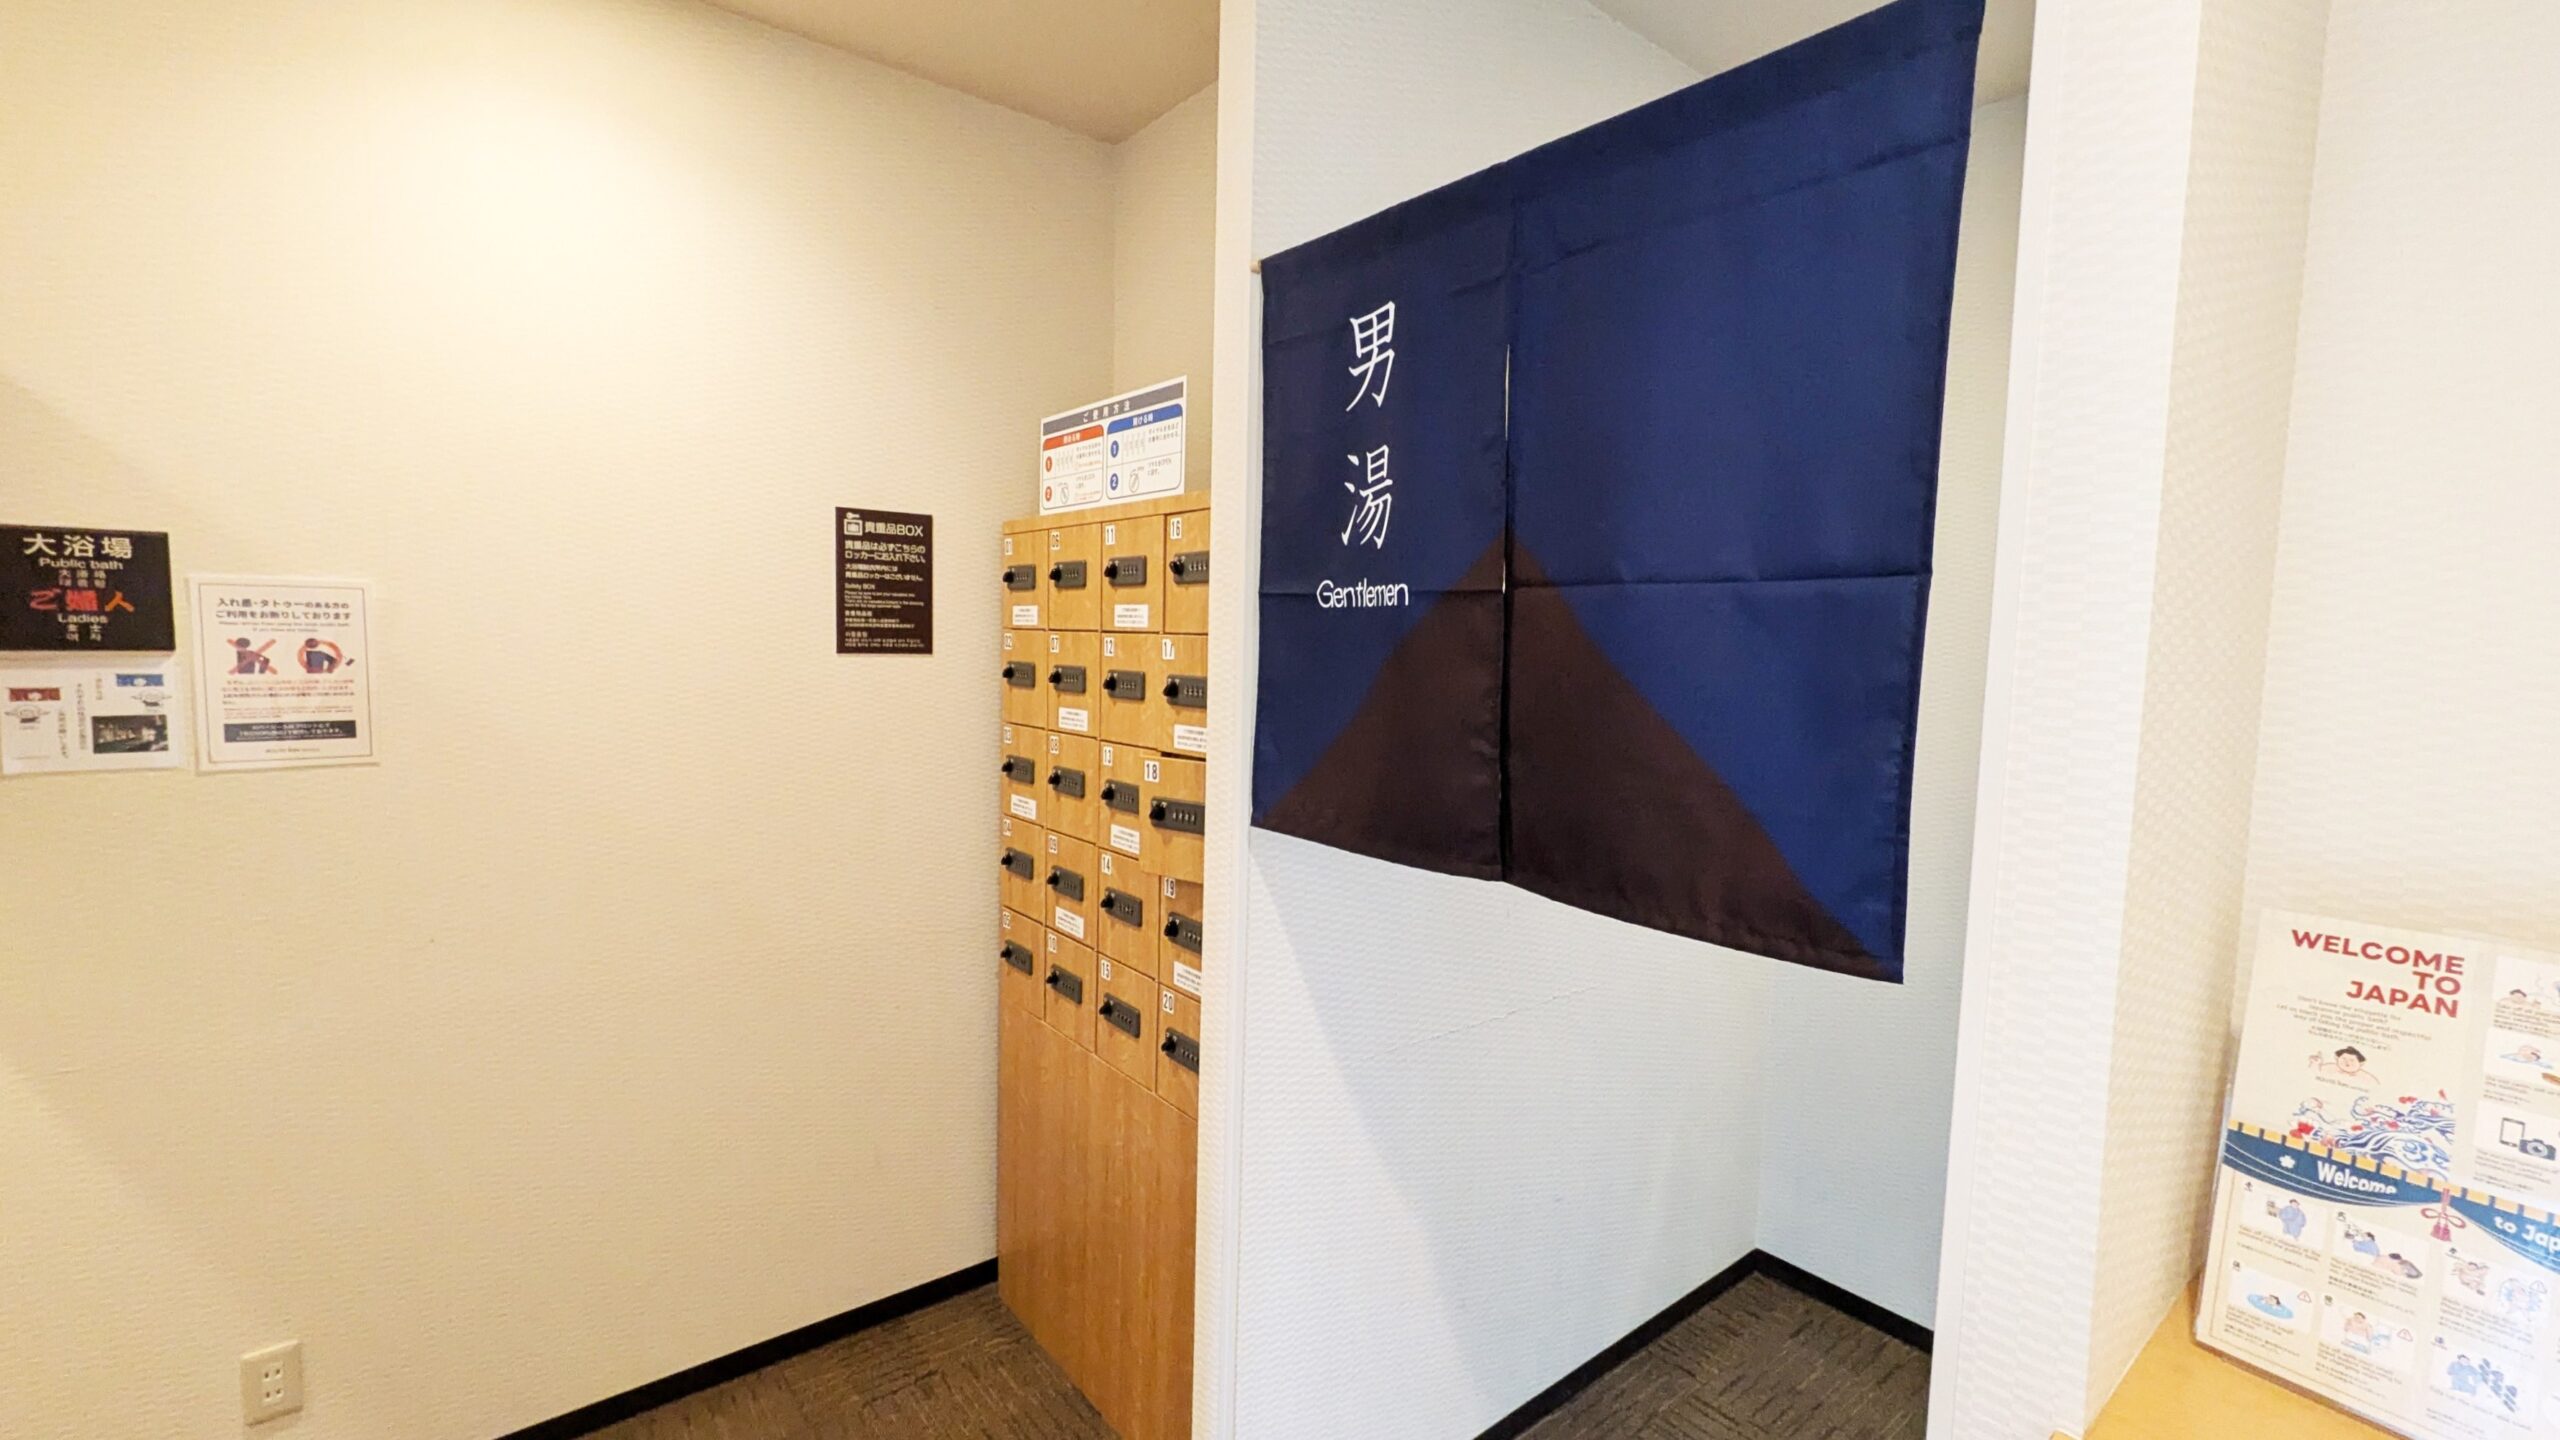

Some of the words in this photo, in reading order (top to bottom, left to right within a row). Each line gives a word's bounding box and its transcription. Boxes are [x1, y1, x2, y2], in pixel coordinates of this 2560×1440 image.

[1341, 300, 1396, 550] 男湯
[865, 521, 924, 537] 貴重品BOX
[1106, 528, 1114, 542] 11
[1172, 520, 1181, 537] 16
[23, 533, 133, 559] 大浴場
[38, 557, 86, 568] Public
[90, 559, 124, 570] bath
[1316, 578, 1409, 609] Gentlemen
[57, 613, 109, 624] Ladies
[1105, 640, 1114, 654] 12
[1146, 764, 1157, 780] 18
[1102, 857, 1110, 871] 14
[1166, 881, 1175, 896] 19
[2291, 929, 2465, 976] WELCOME
[1102, 962, 1110, 978] 15
[2412, 970, 2461, 995] TO
[1164, 993, 1173, 1011] 20
[2346, 980, 2459, 1018] JAPAN
[2316, 1160, 2398, 1194] Welcome
[2494, 1216, 2517, 1234] to
